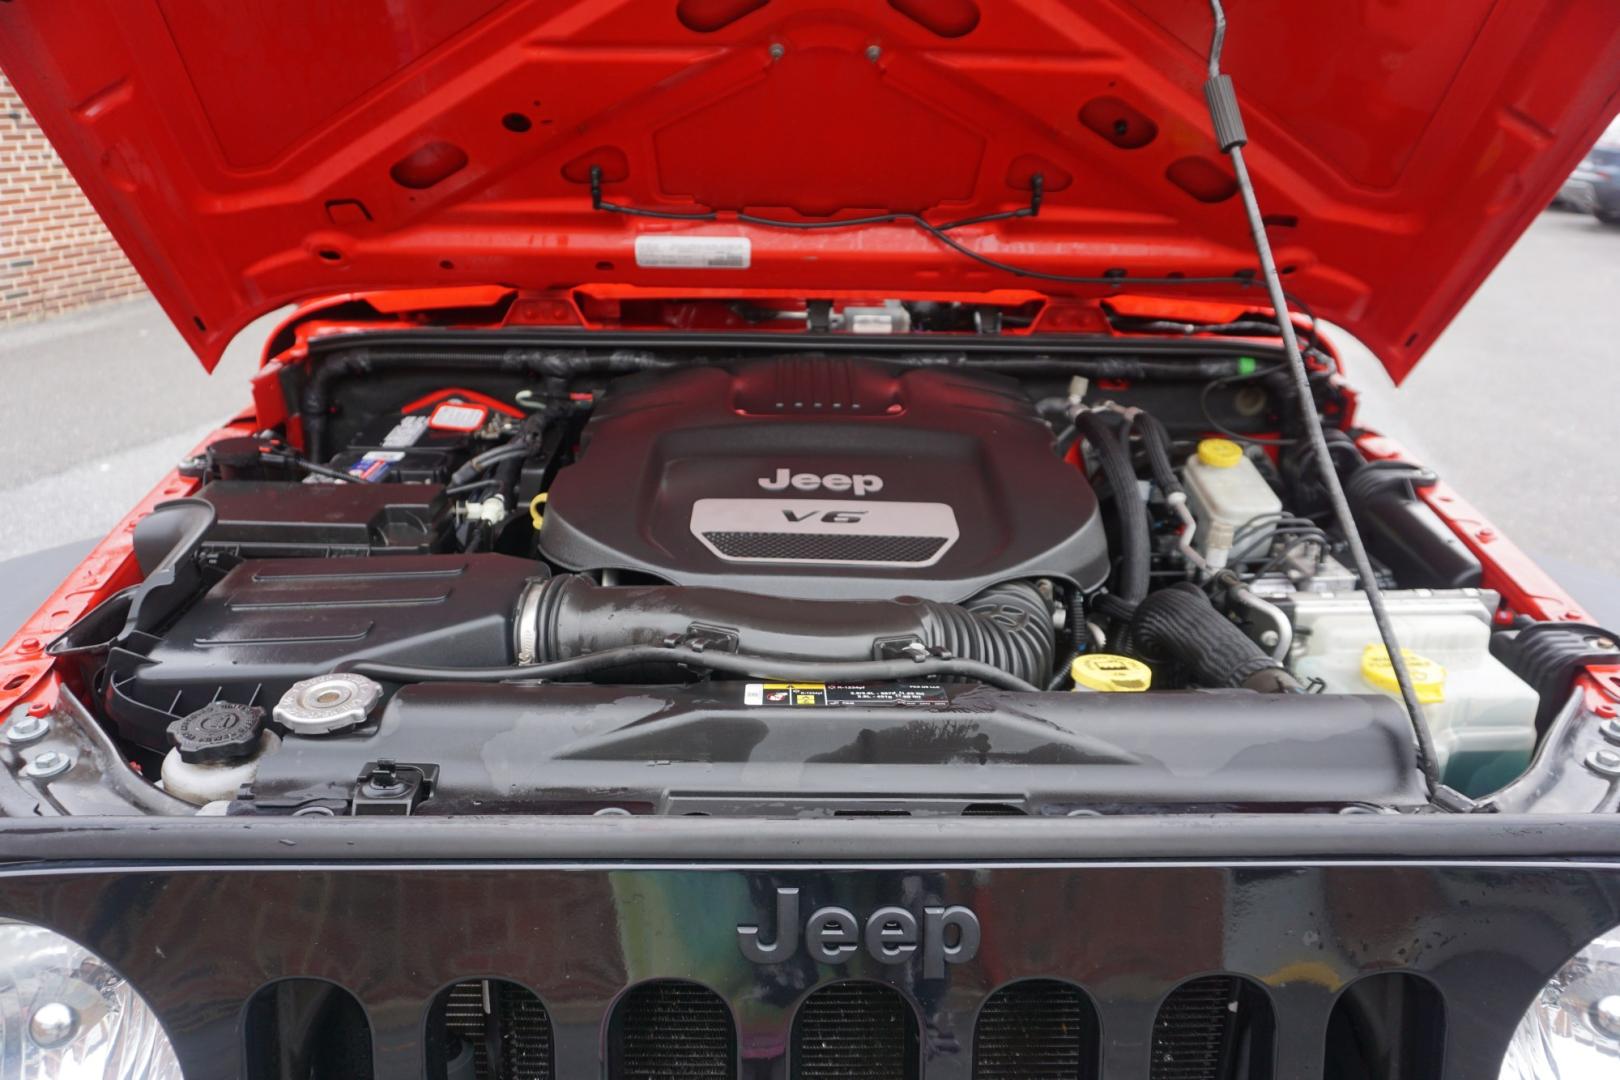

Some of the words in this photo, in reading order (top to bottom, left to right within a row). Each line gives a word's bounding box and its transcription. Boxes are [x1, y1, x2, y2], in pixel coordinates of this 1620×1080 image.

[758, 468, 884, 496] Jeep
[782, 509, 869, 524] V6
[736, 887, 981, 979] Jeep
